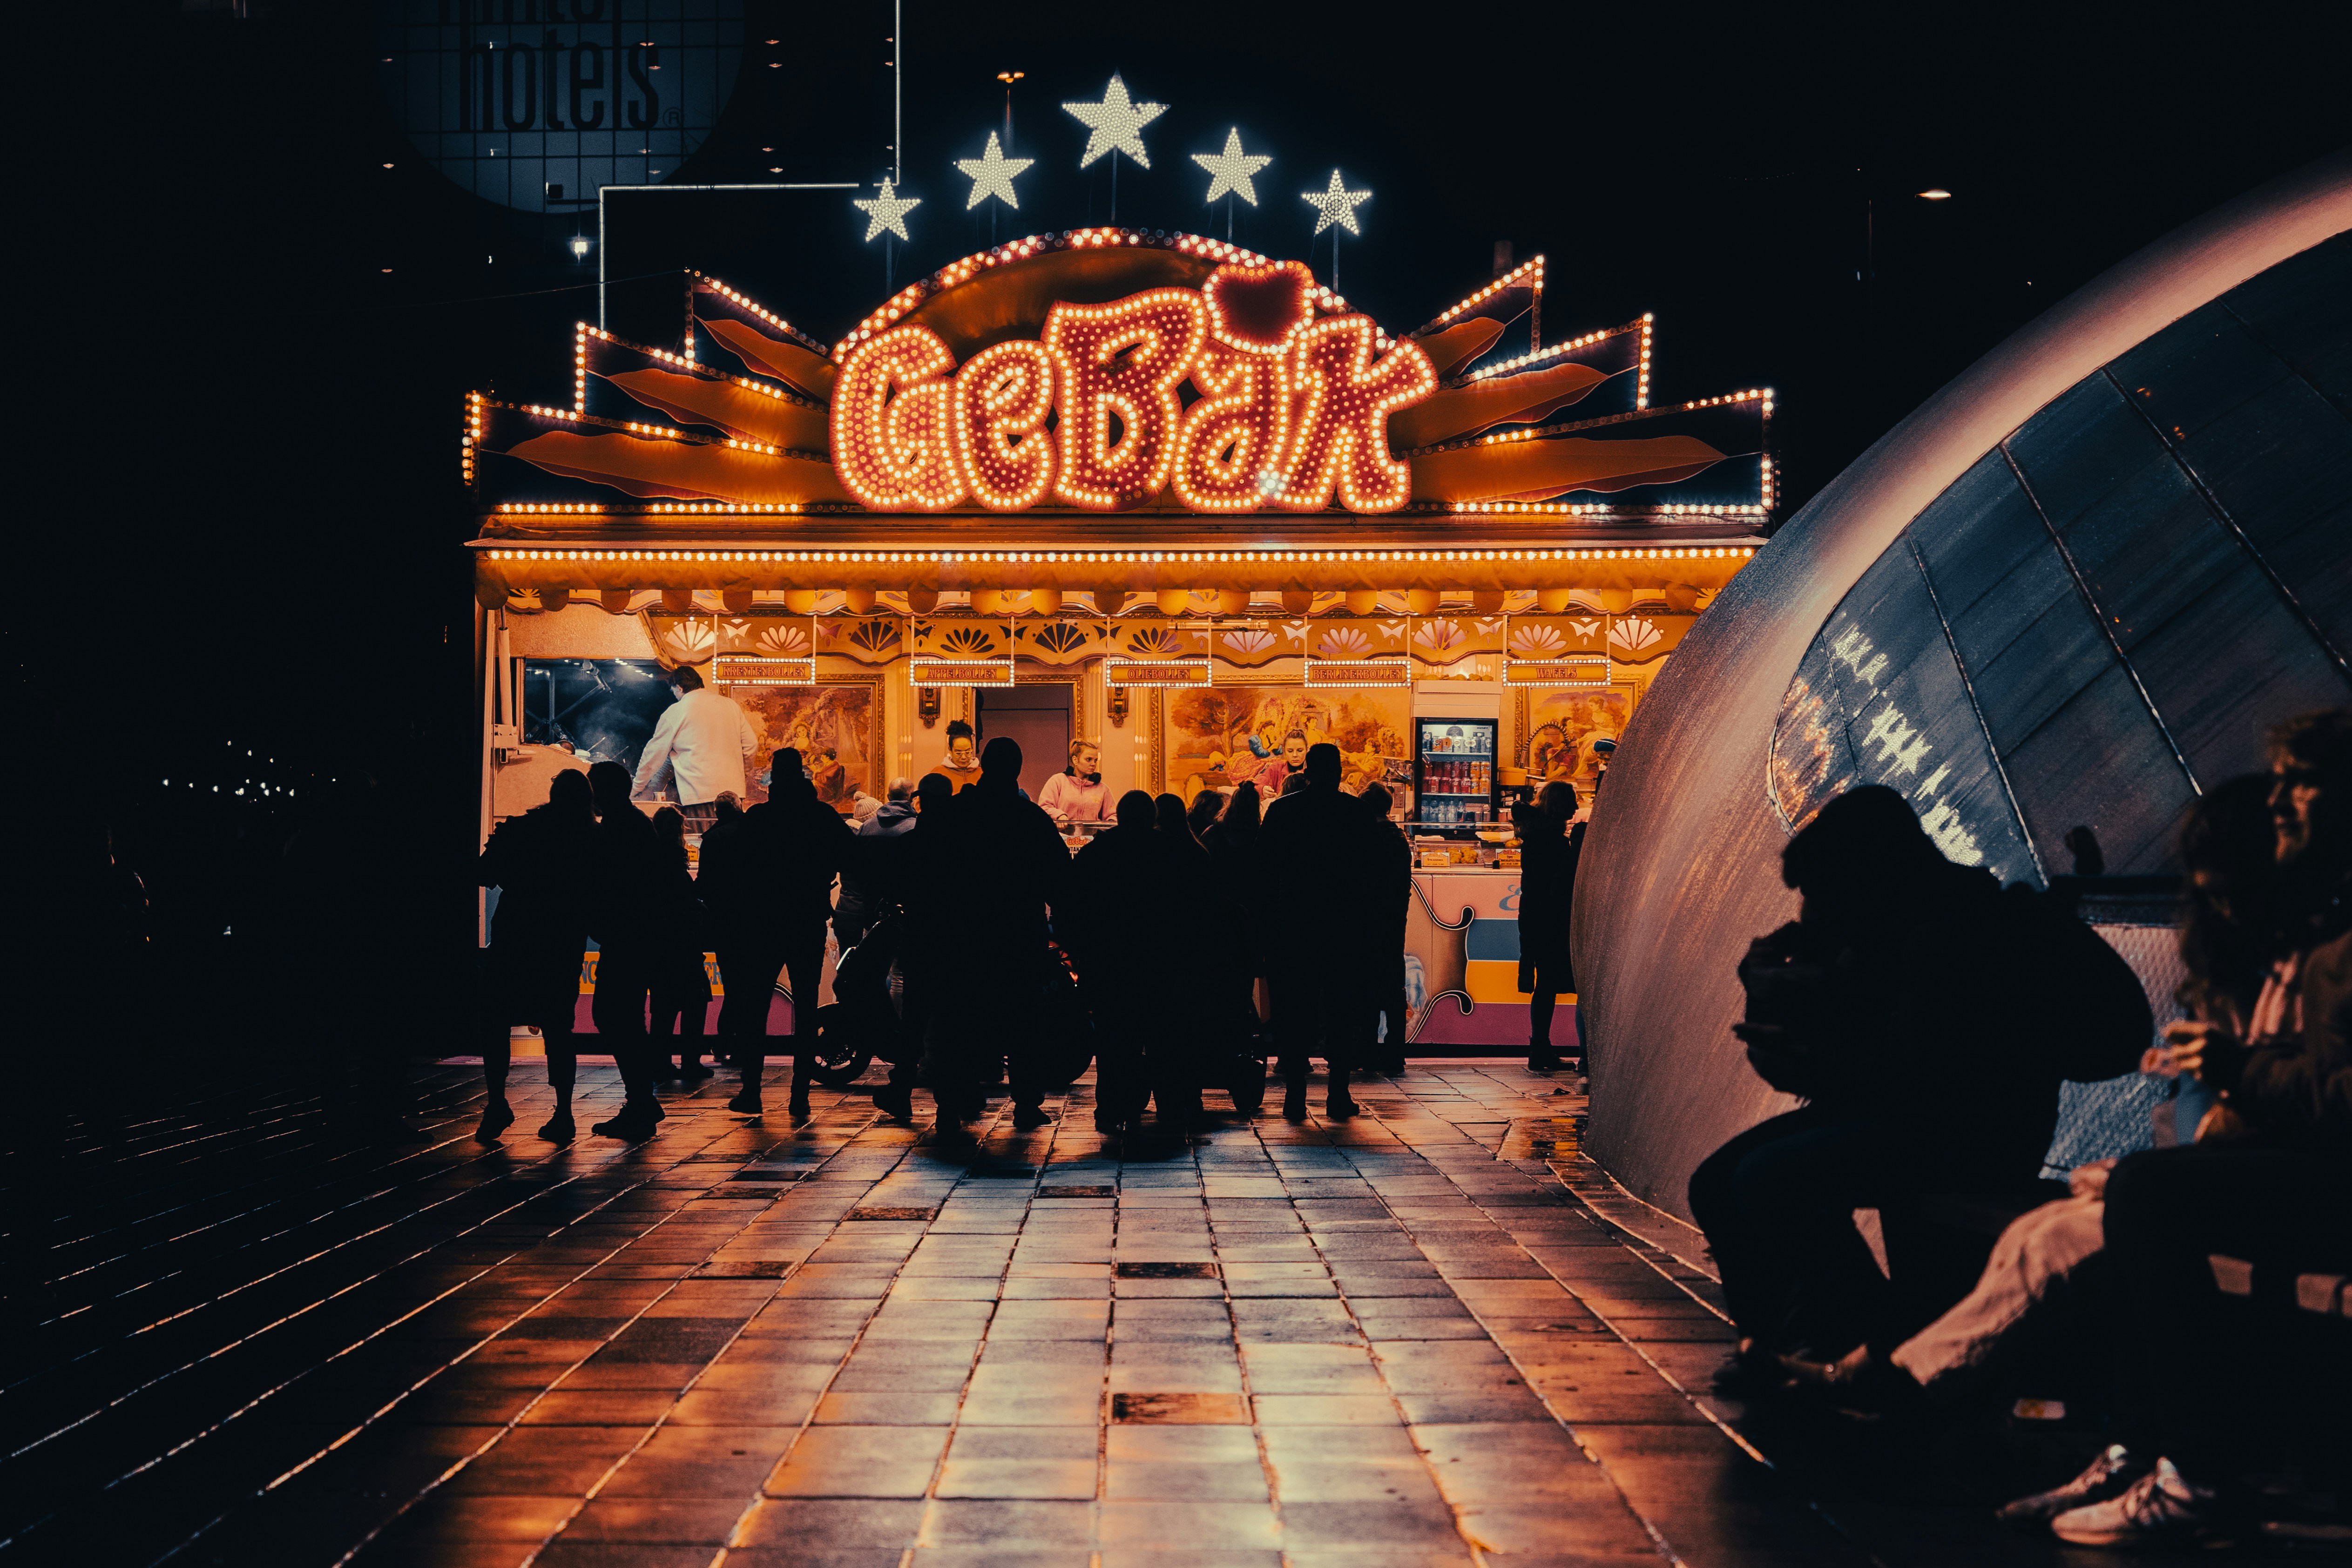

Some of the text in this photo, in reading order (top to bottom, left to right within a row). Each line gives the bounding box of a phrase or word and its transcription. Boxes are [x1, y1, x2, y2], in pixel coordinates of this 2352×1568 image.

[723, 666, 806, 677] KRENTENBOLLEN
[926, 668, 997, 679] APPELBOLLEN
[1128, 669, 1190, 679] OLIEBOLLEN
[1312, 669, 1403, 679] BERLINERBOLLEN
[1536, 667, 1577, 678] WAFELS
